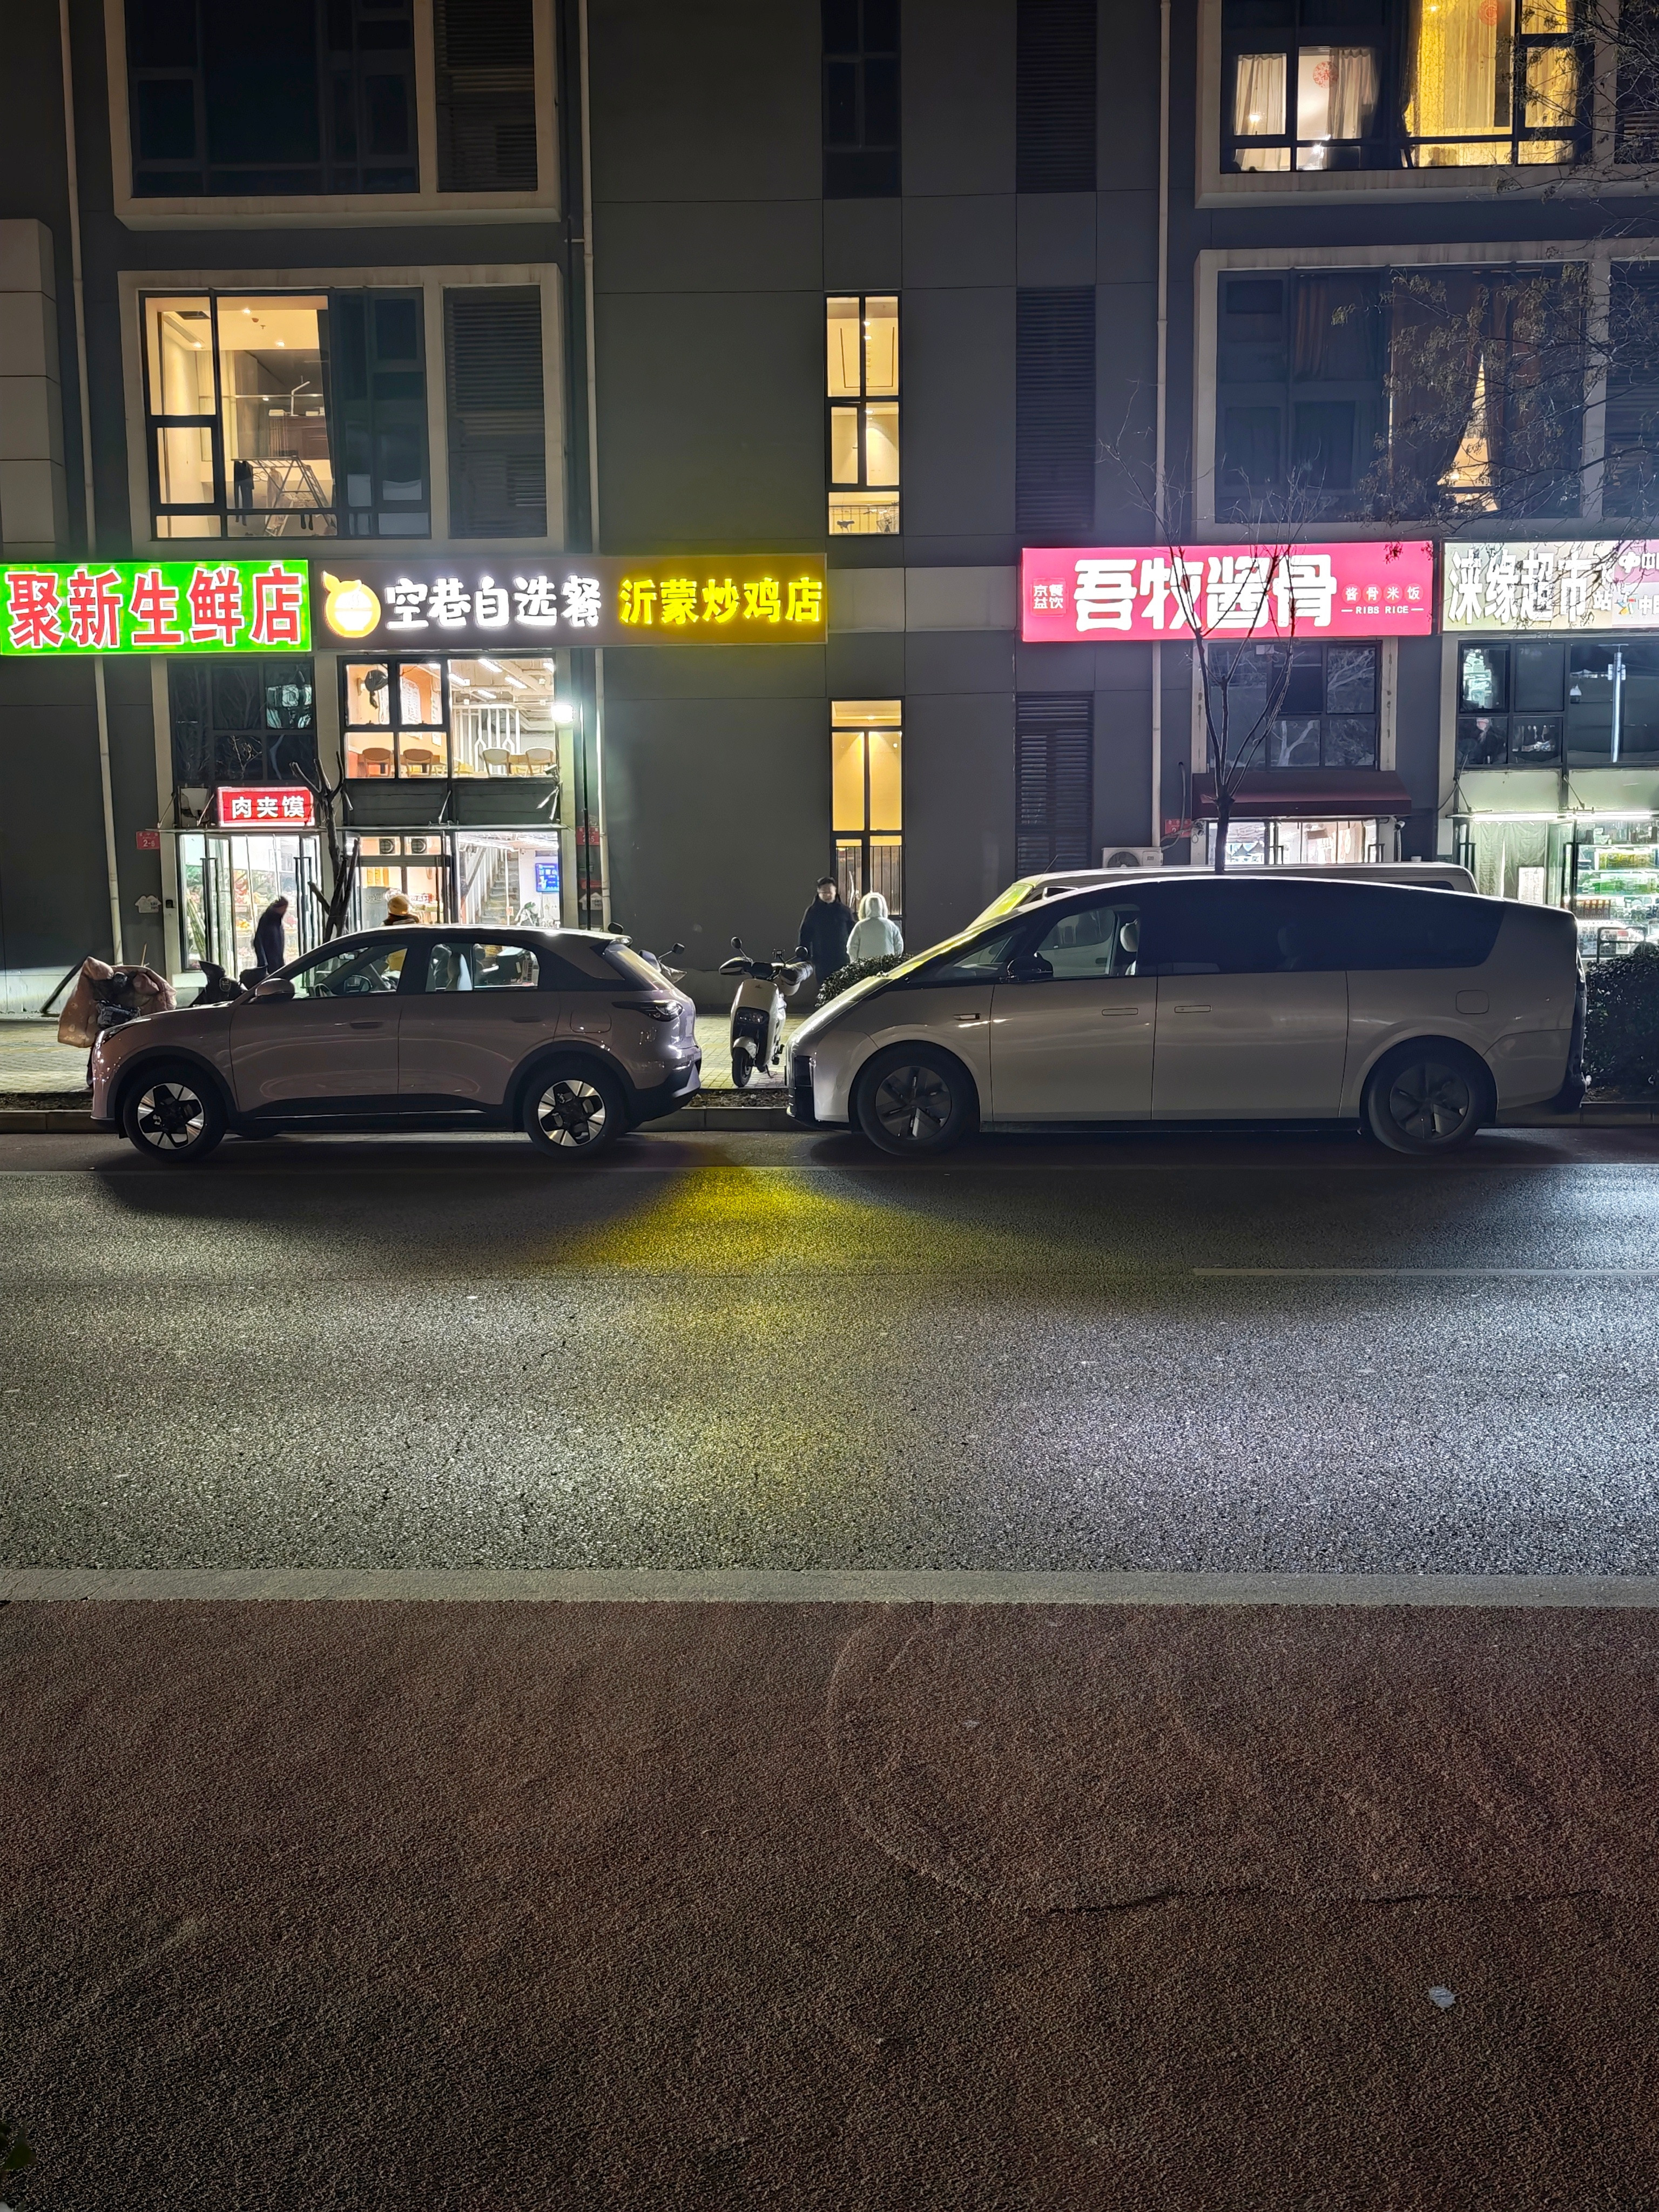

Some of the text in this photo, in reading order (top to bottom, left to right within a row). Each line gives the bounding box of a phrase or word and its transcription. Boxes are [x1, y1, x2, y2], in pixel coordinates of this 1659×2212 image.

[5, 566, 304, 649] 聚新生鲜店
[386, 574, 602, 629] 空巷自选餐
[619, 576, 823, 624] 沂蒙炒鸡店
[1073, 554, 1338, 632] 吾牧酱骨
[1345, 586, 1421, 601] 酱骨米饭
[1355, 605, 1409, 614] RIBS RICE
[232, 795, 305, 819] 肉夹馍
